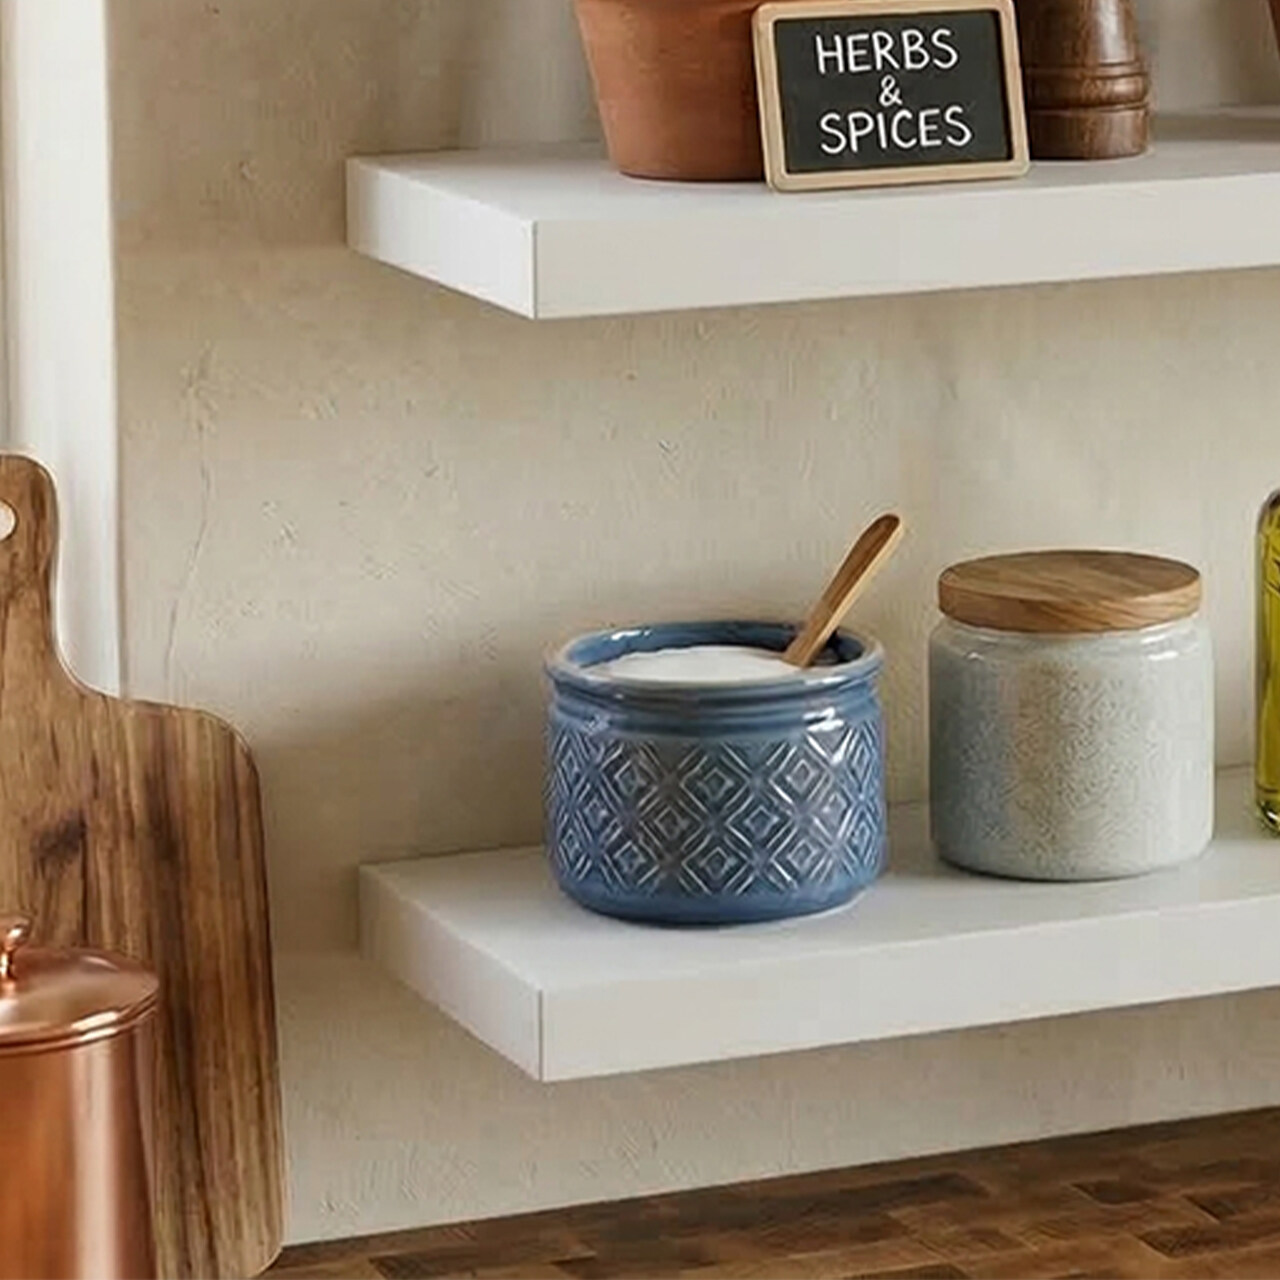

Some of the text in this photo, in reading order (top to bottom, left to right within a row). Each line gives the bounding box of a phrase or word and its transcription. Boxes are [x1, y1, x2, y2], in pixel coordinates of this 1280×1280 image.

[816, 28, 958, 73] HERBS
[879, 75, 902, 107] &
[820, 106, 972, 154] SPICES
